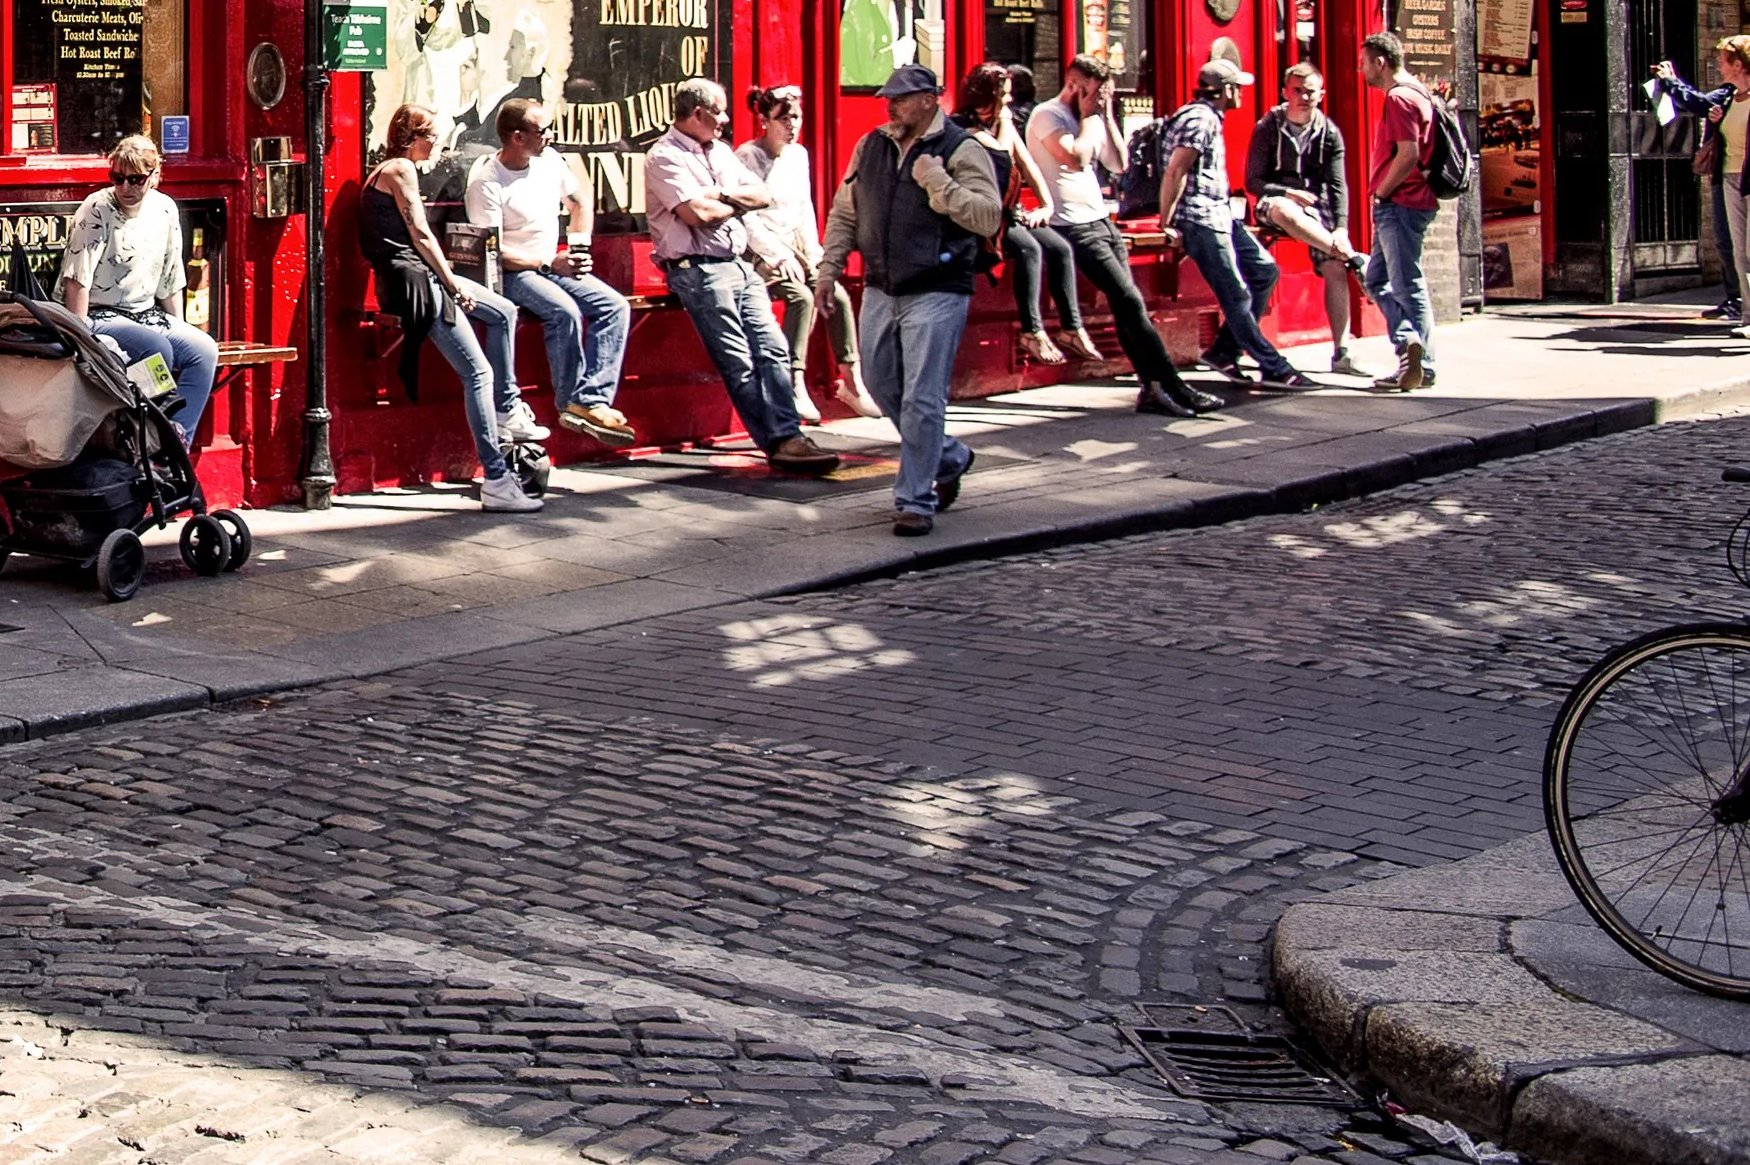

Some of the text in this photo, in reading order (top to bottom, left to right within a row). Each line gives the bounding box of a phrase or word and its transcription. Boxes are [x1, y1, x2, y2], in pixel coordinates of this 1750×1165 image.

[52, 10, 99, 23] Charcuterie
[101, 11, 127, 26] Meats,
[63, 28, 139, 42] Toasted Sandwiche
[61, 46, 76, 59] Hot
[79, 46, 101, 59] Roast
[104, 46, 122, 59] Beef
[680, 36, 709, 77] OF
[552, 100, 622, 145] ALTED
